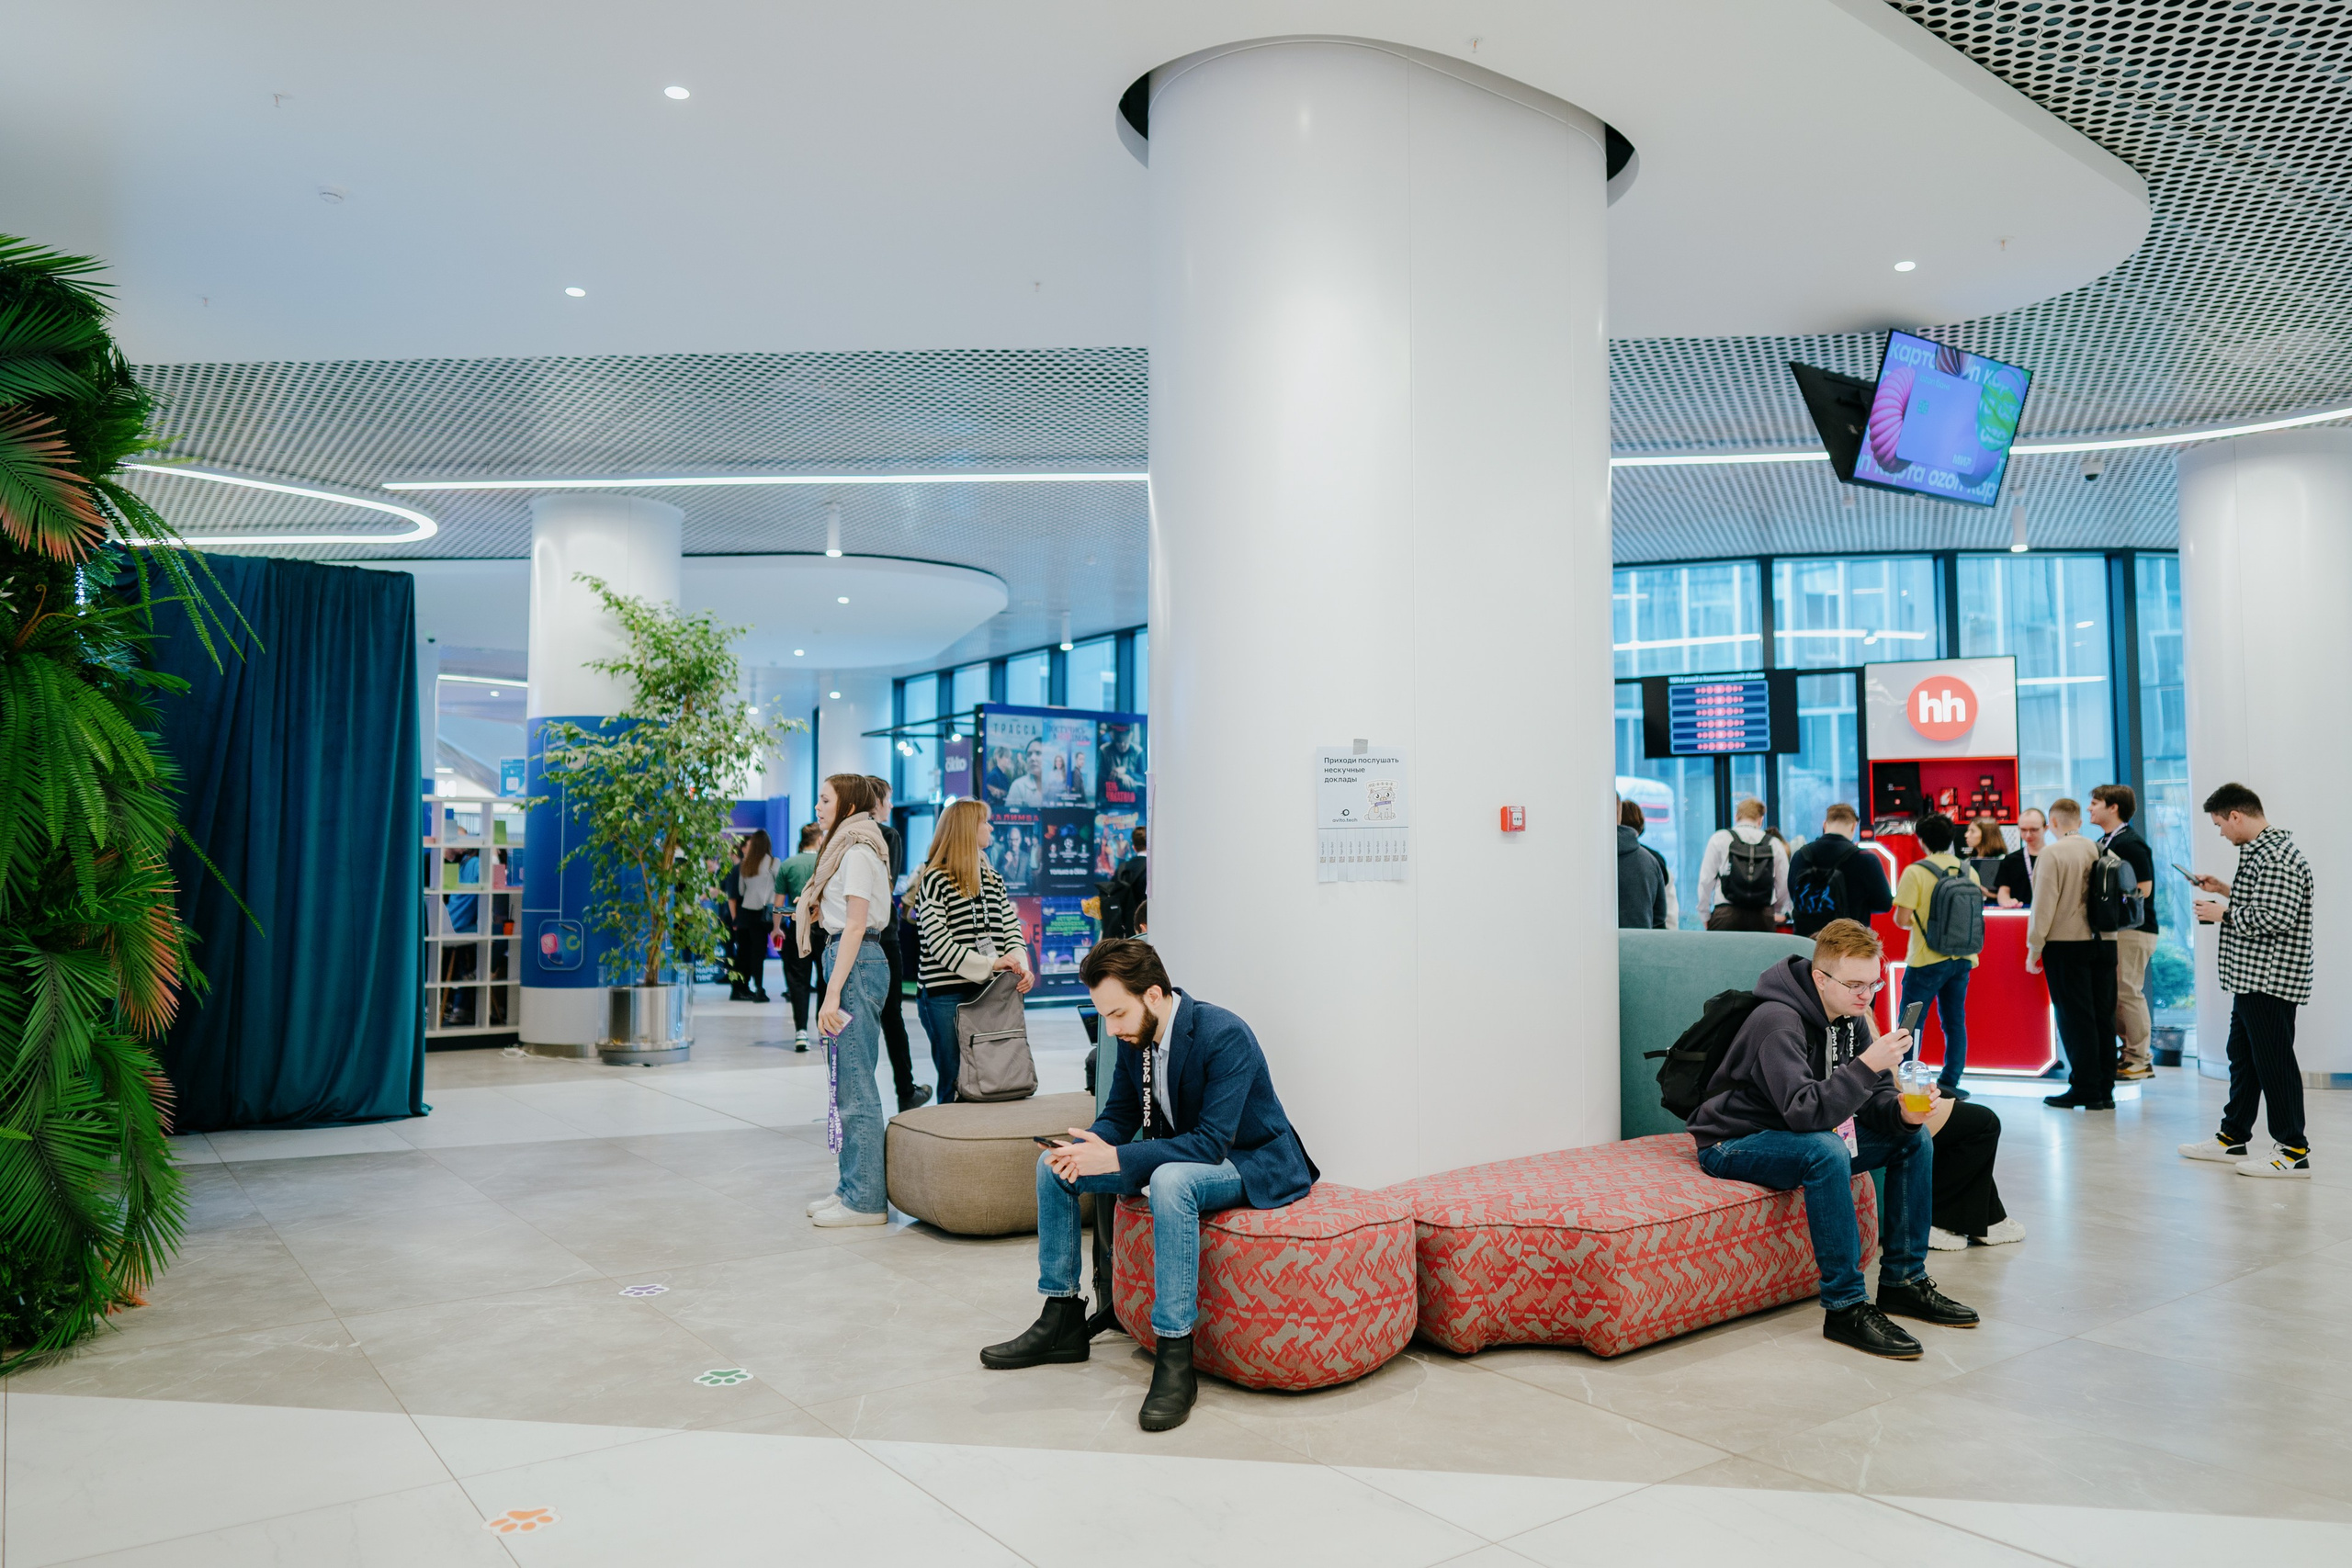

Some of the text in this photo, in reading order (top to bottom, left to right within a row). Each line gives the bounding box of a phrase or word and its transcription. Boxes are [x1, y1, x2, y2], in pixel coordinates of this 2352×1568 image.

[1918, 690, 1966, 723] hh
[994, 723, 1036, 735] ТРАССА
[1143, 1045, 1151, 1127] MMAS MMAS
[833, 1106, 842, 1134] MMAS
